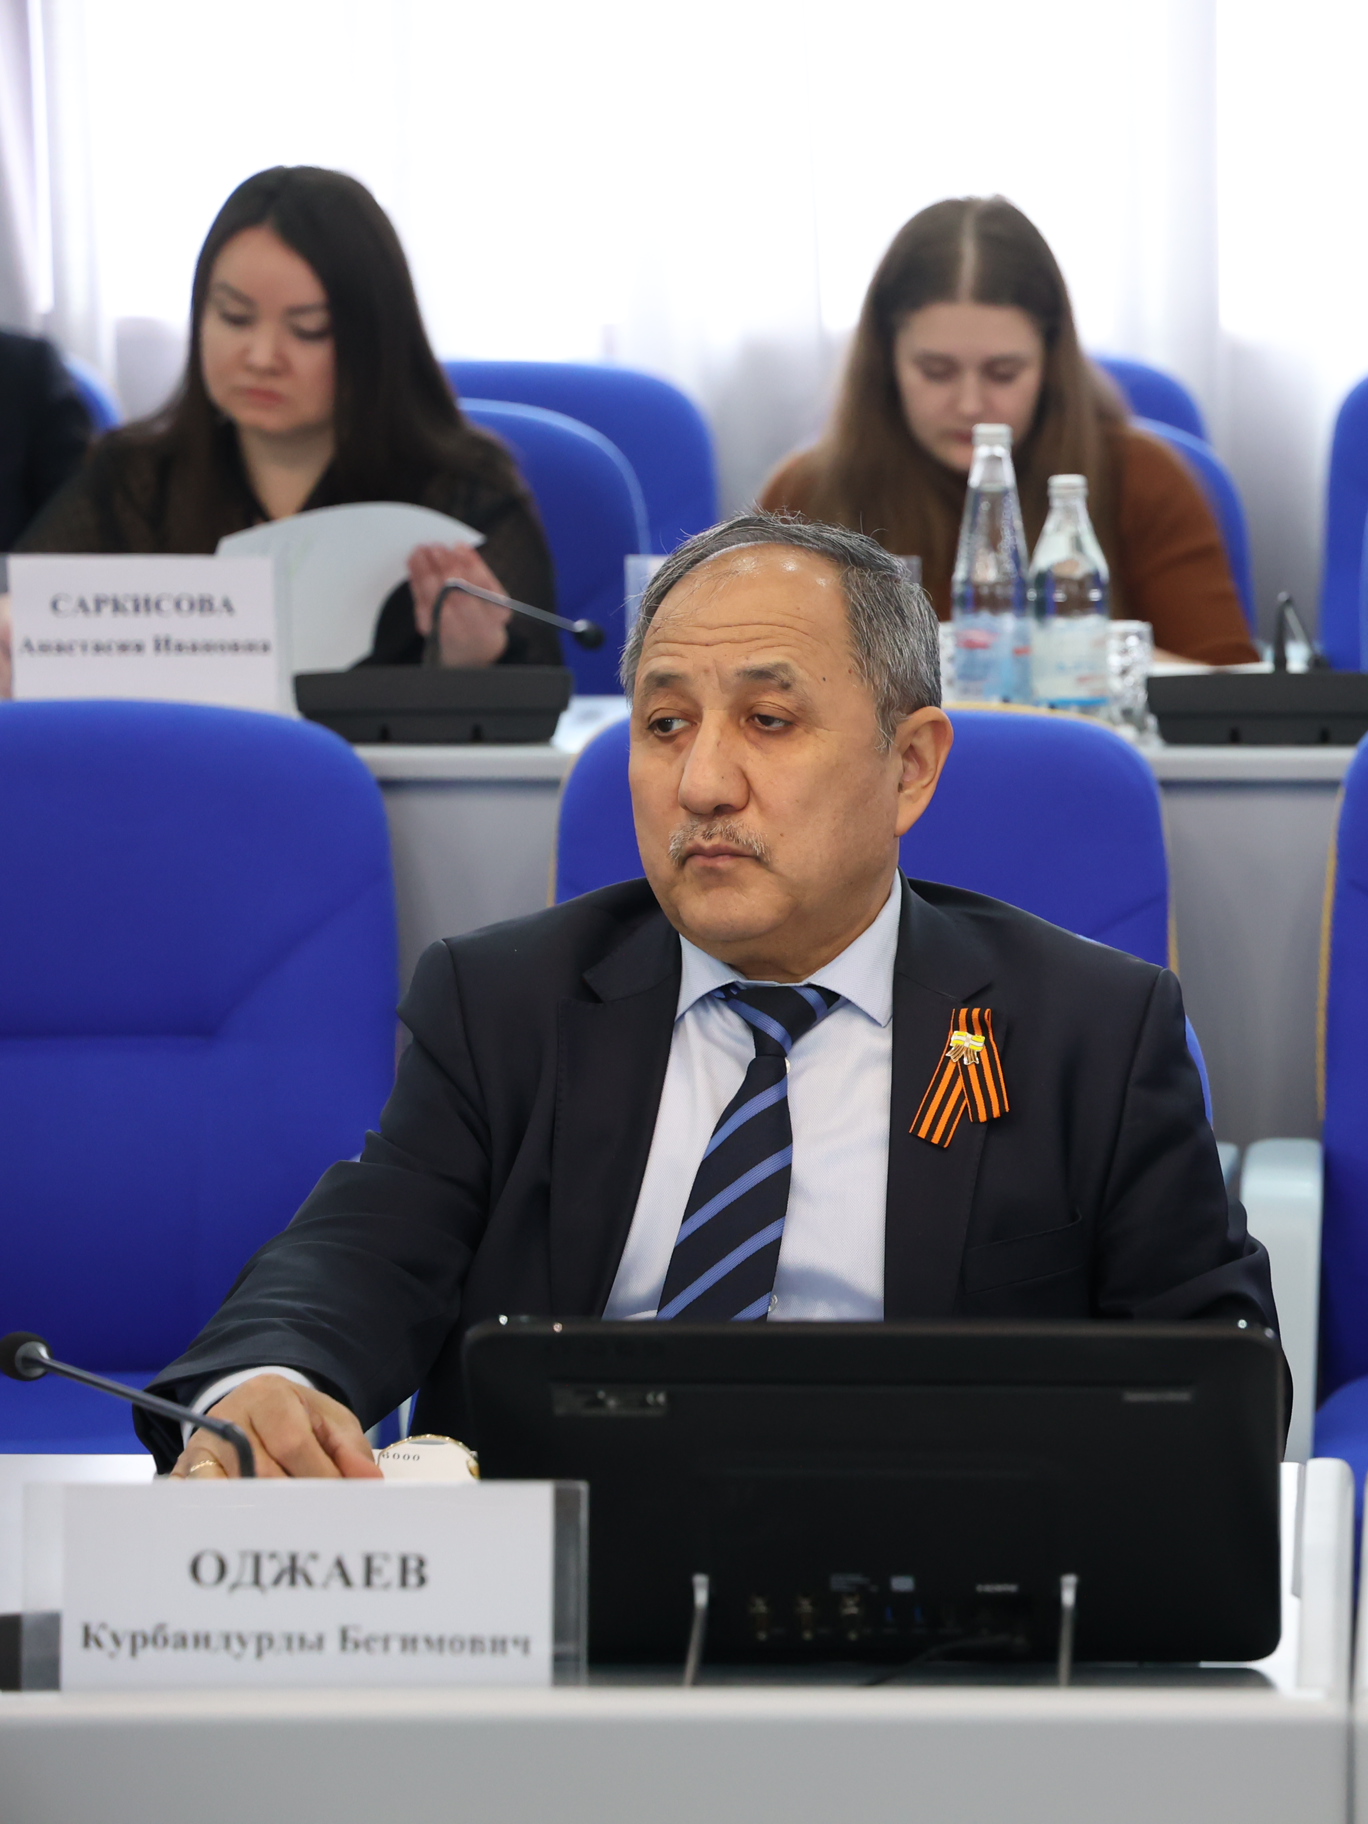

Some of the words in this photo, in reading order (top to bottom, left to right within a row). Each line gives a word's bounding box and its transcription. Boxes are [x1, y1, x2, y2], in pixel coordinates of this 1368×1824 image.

[50, 593, 237, 618] САРКИСОВА
[189, 1552, 430, 1593] ОДЖАЕВ
[82, 1622, 325, 1660] Курбандурды
[340, 1625, 532, 1657] Бегимович
